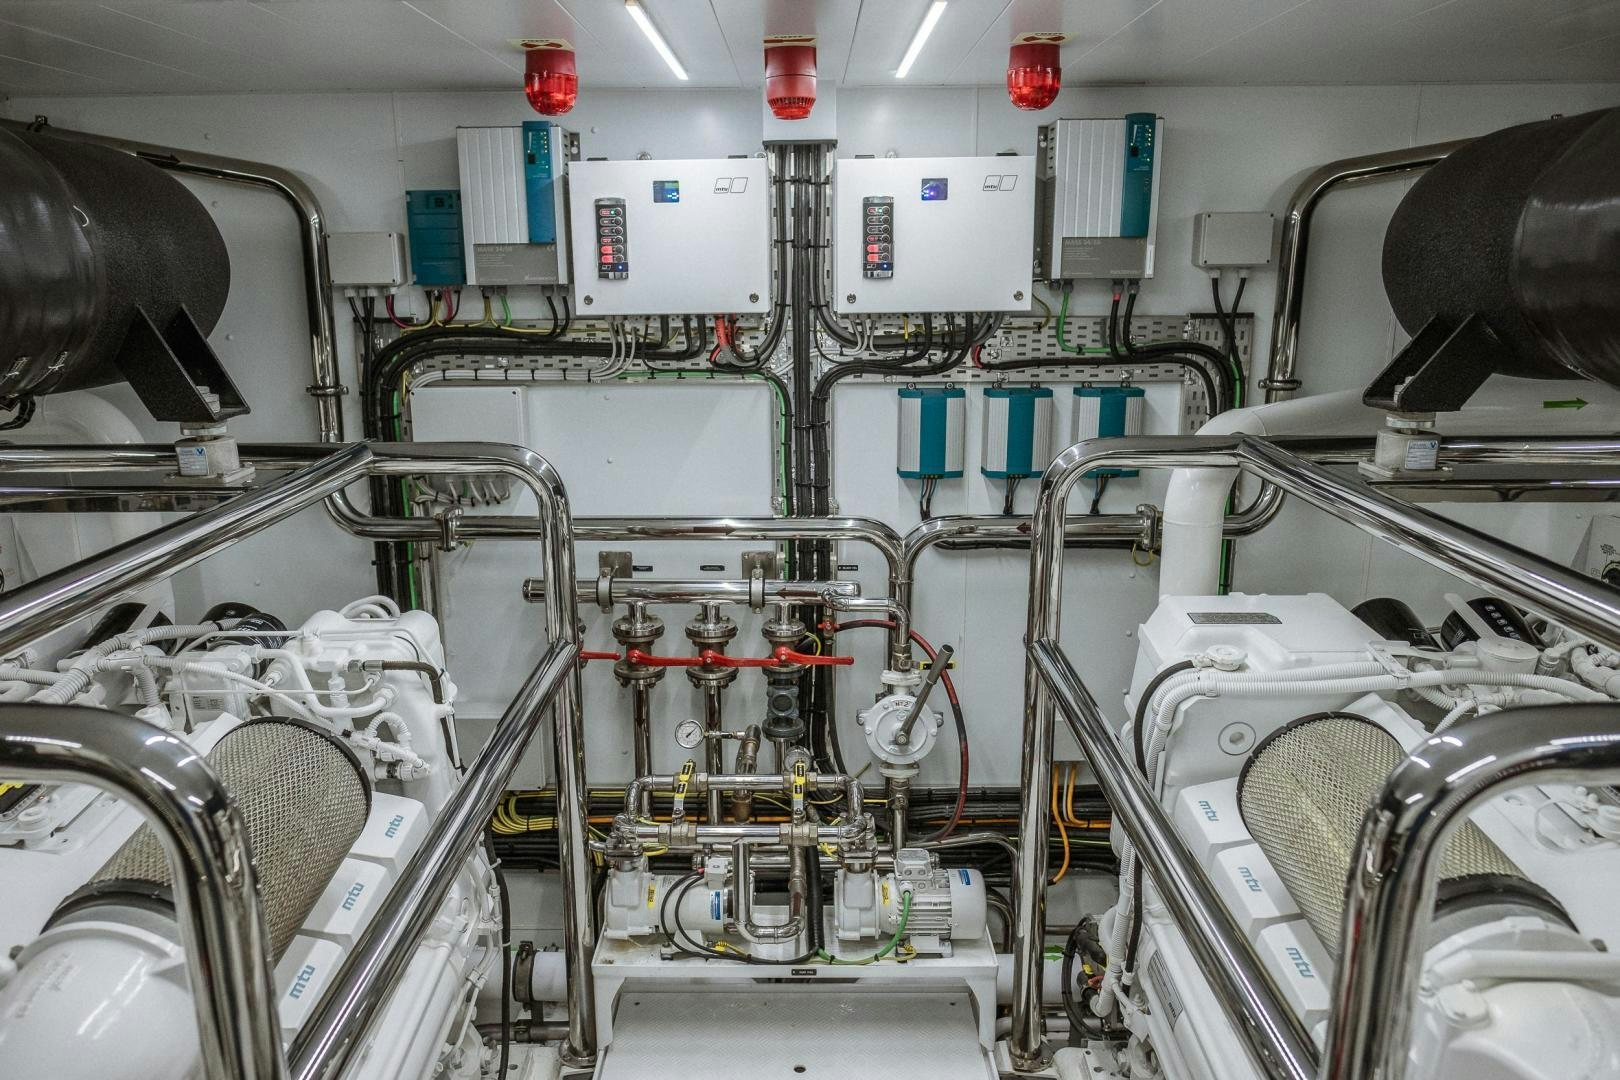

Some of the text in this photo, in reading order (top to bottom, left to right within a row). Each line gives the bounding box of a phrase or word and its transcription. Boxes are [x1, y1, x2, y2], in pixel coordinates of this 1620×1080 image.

[1199, 801, 1219, 822] mtu
[385, 815, 404, 838] mtu
[1238, 866, 1262, 893] mtu
[342, 883, 364, 911] mtu
[1286, 947, 1314, 977] mtu
[289, 964, 315, 1000] mtu
